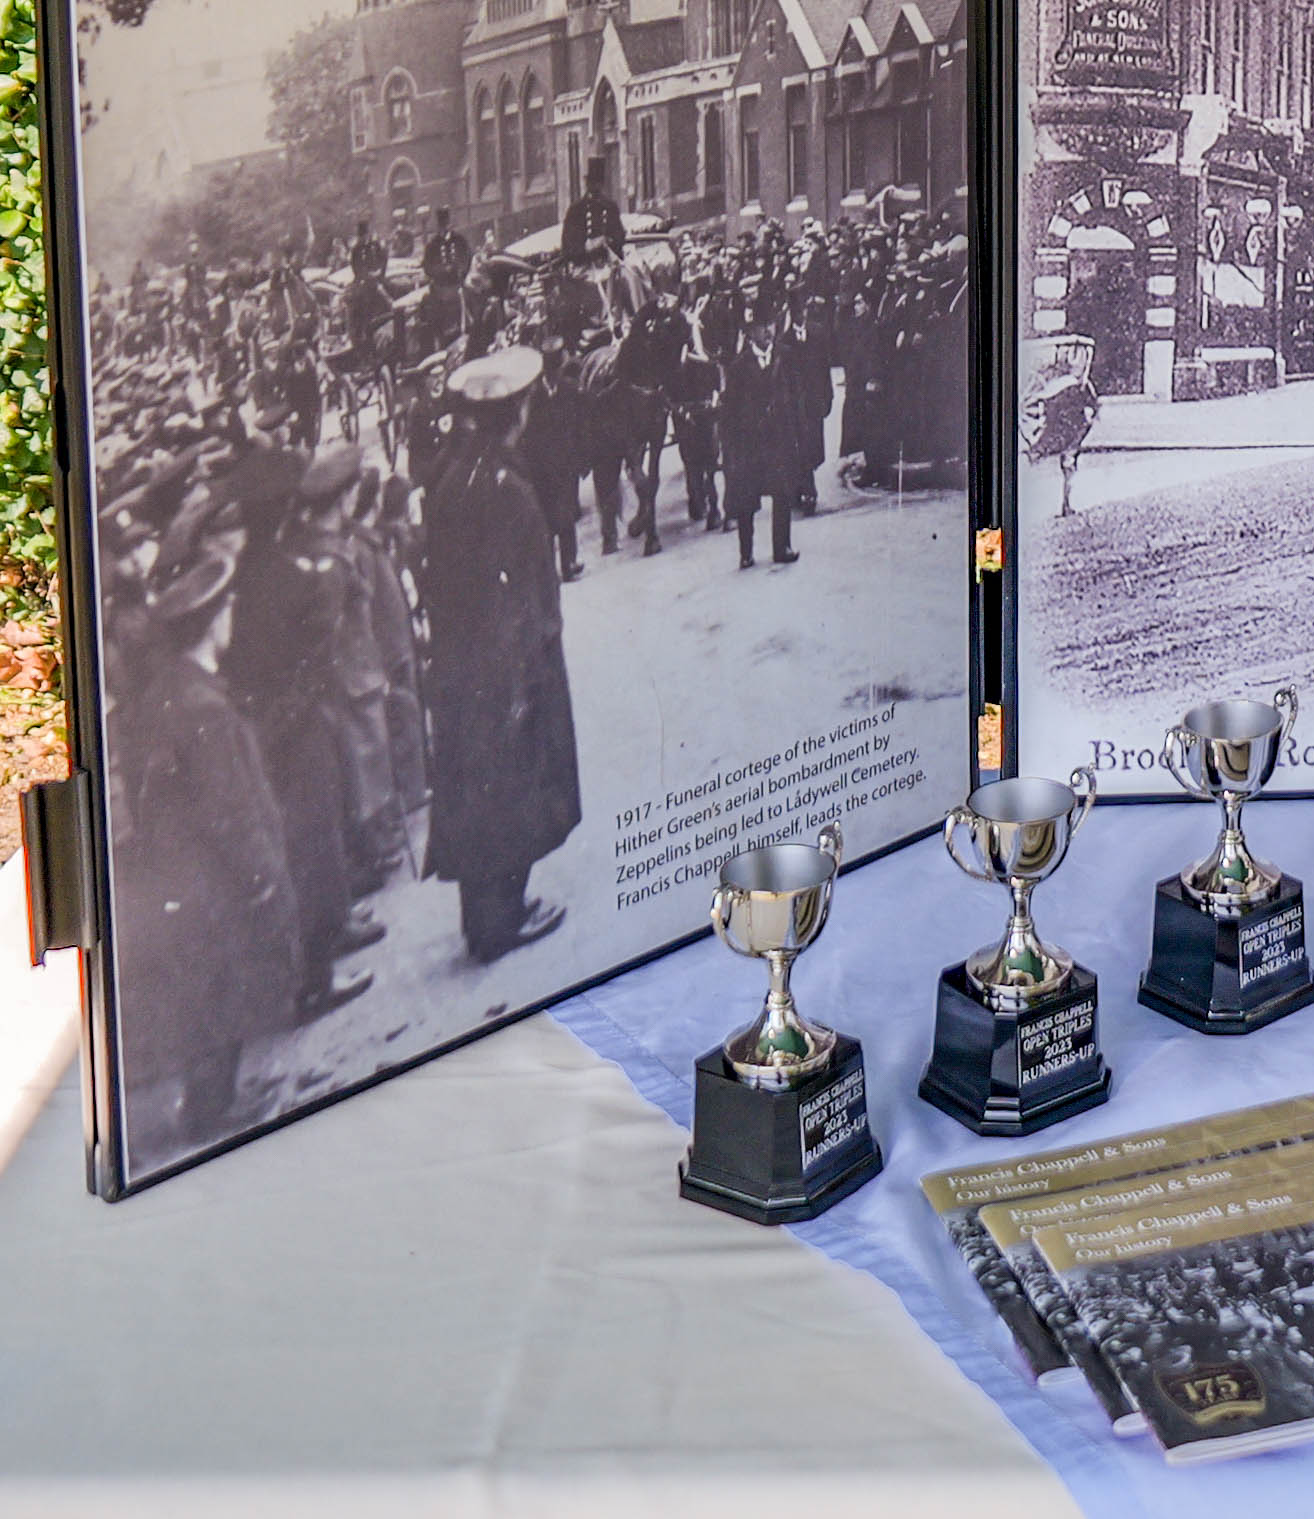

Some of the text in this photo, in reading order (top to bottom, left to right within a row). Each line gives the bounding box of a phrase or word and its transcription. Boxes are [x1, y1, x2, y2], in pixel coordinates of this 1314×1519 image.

[616, 803, 651, 829] 1917
[666, 773, 721, 810] Funeral
[725, 753, 781, 786] cortege
[785, 741, 800, 762] of
[803, 734, 825, 757] the
[829, 715, 878, 744] victims
[882, 703, 896, 722] of
[615, 734, 891, 857] Hither Green's aerial bombardment by
[1021, 1001, 1093, 1038] FRANCIS CHAPPELL
[1023, 1014, 1092, 1052] OPEN TRIPLES
[1022, 1043, 1096, 1084] RUNNERS-UP
[1044, 1039, 1072, 1059] 2023
[1065, 1193, 1292, 1246] Francis Chappell & Sons
[1075, 1235, 1174, 1260] Our history
[1183, 1375, 1241, 1406] 175
